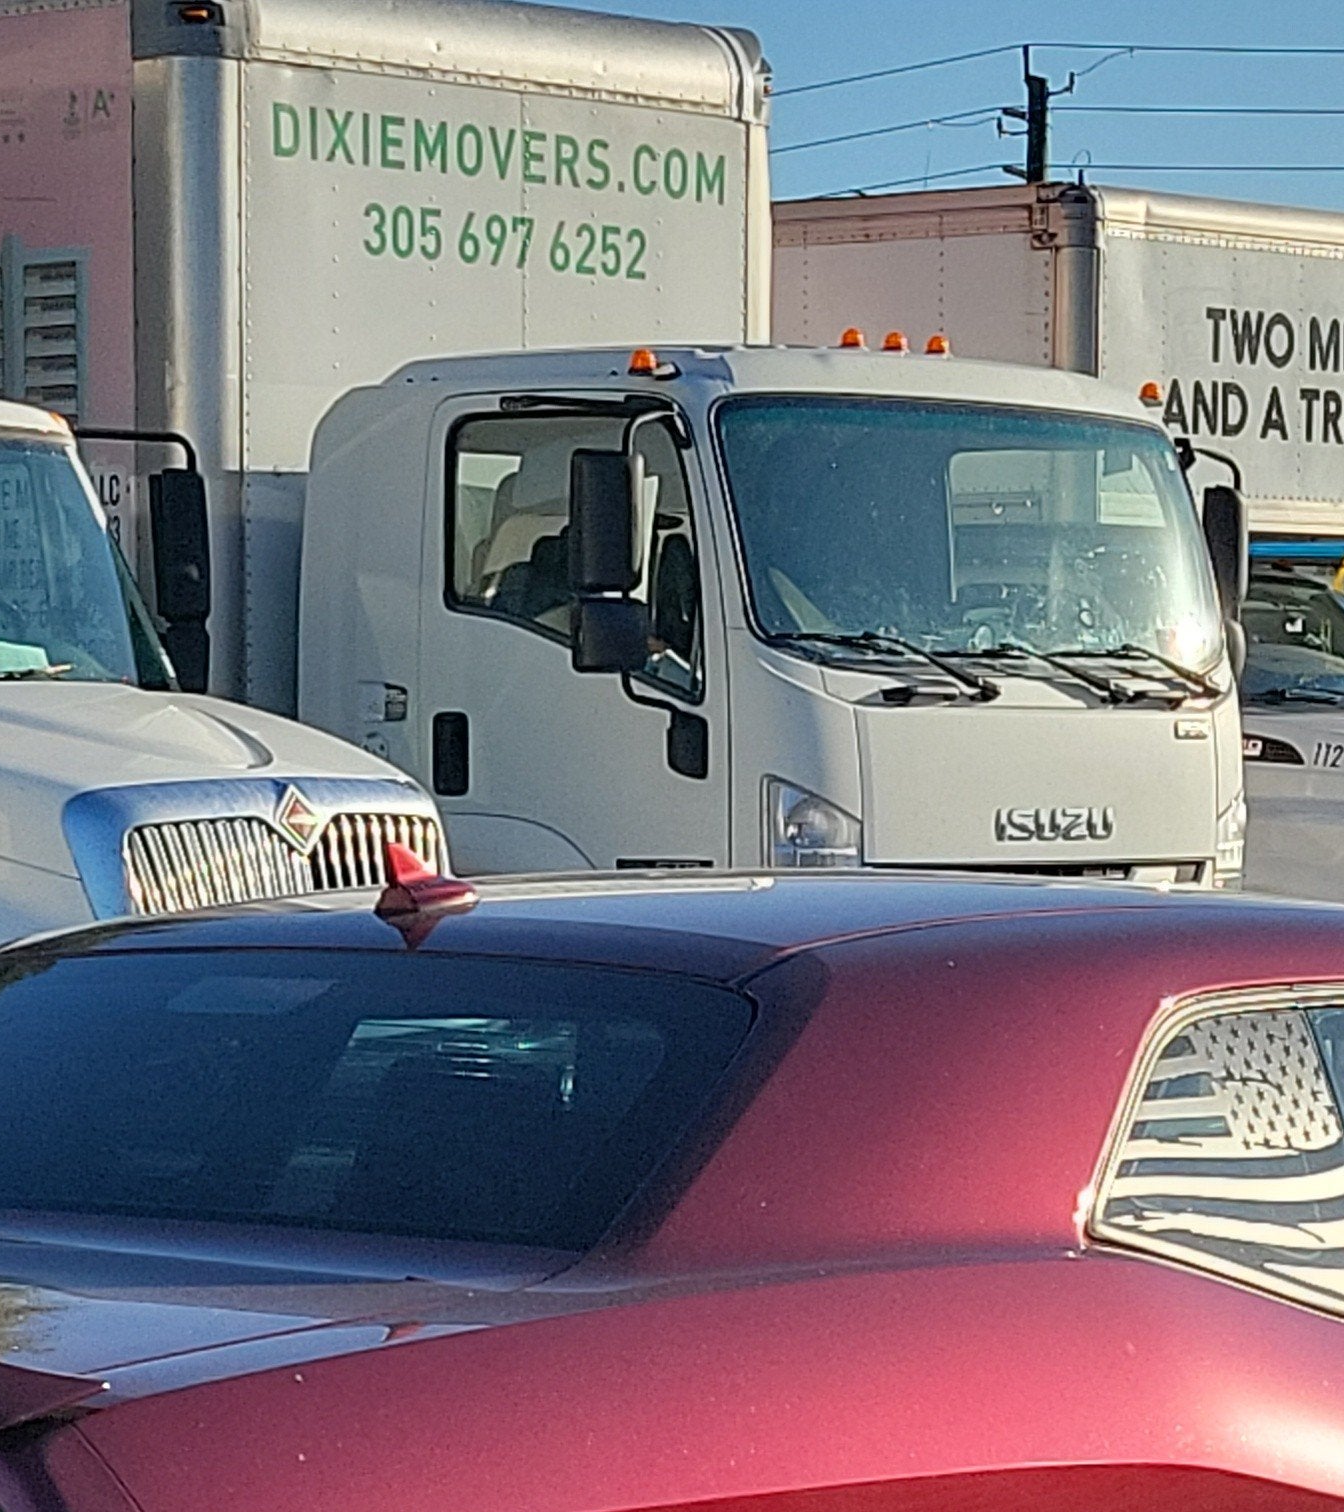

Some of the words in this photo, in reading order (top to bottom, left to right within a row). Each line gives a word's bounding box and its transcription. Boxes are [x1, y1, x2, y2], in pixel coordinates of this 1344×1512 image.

[272, 102, 727, 207] DIXIEMOVERS.COM
[362, 202, 443, 261] 305
[458, 211, 534, 269] 697
[549, 220, 647, 280] 6252
[1206, 306, 1294, 368] TWO
[1162, 377, 1249, 437] AND
[1260, 386, 1288, 440] A
[994, 807, 1114, 842] ISUZU
